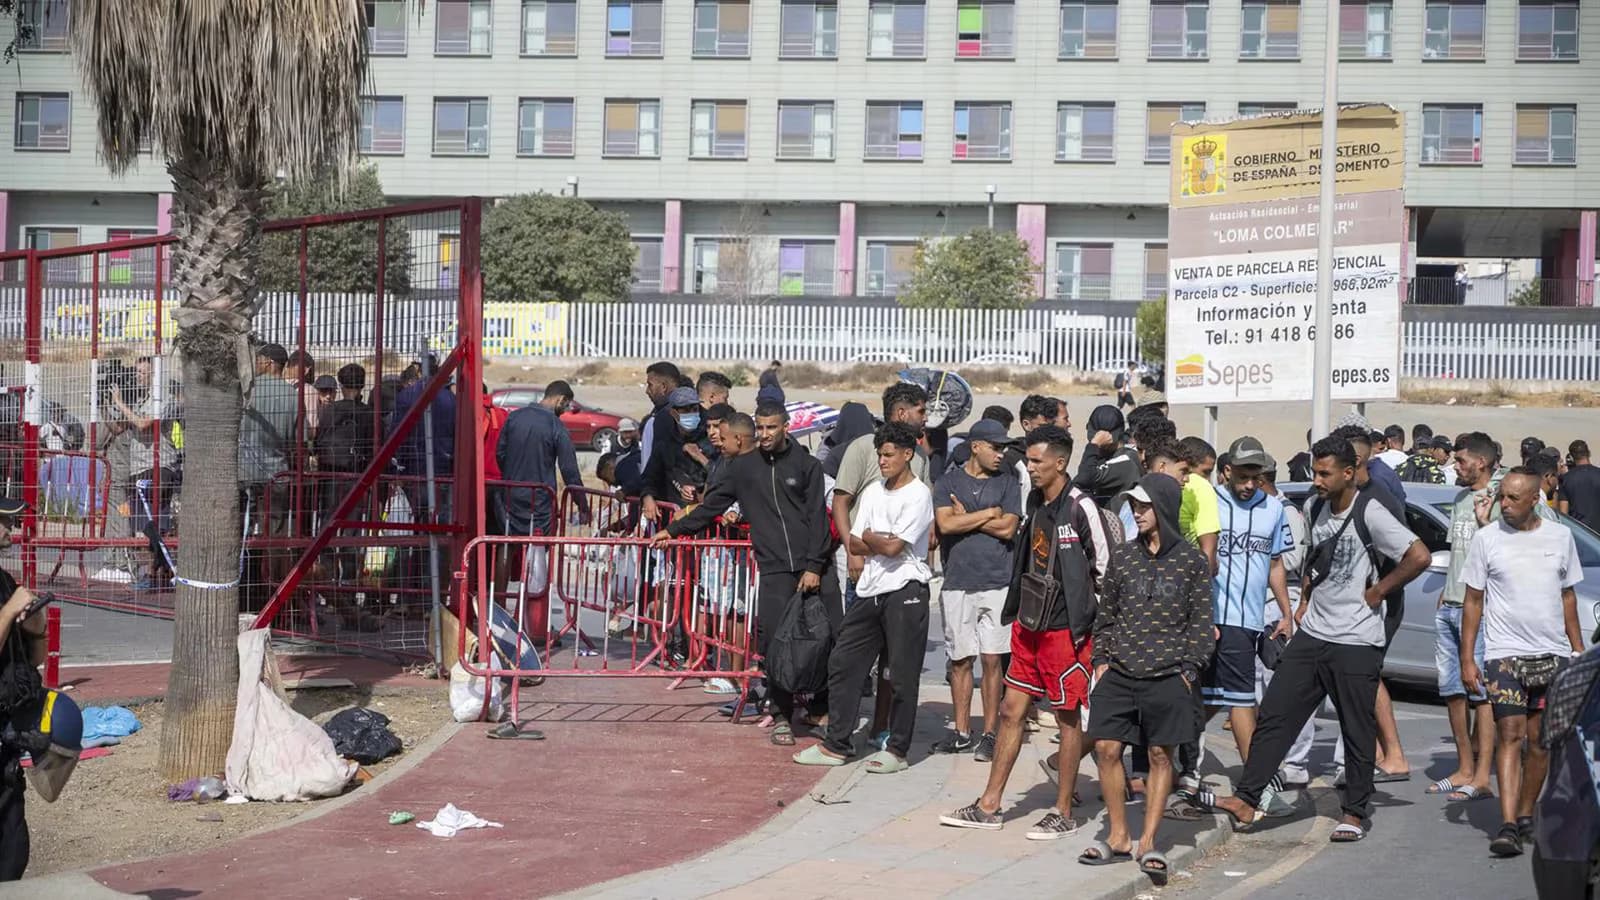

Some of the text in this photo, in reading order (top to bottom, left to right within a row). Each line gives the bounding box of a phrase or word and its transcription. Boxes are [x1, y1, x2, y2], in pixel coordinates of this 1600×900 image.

[1233, 151, 1296, 167] GOBIERNO
[1309, 142, 1381, 160] MISTERIO
[1233, 164, 1297, 182] DE ESPAÑA
[1334, 157, 1390, 173] OMENTO
[1209, 209, 1249, 221] Actuación
[1250, 205, 1299, 218] Residencial
[1307, 200, 1359, 214] Emsarial
[1263, 219, 1354, 241] COLMER"
[1174, 255, 1387, 281] VENTA DE PARCELA REENCIAL
[1174, 287, 1219, 301] Parcela
[1222, 285, 1239, 299] C2
[1250, 280, 1318, 299] Superficie:
[1197, 299, 1367, 323] Información y enta
[1205, 328, 1239, 346] Tel.:
[1245, 327, 1263, 344] 91
[1270, 325, 1301, 343] 418
[1334, 323, 1355, 340] 86
[1207, 359, 1274, 398] Sepes
[1331, 367, 1390, 388] epes.es
